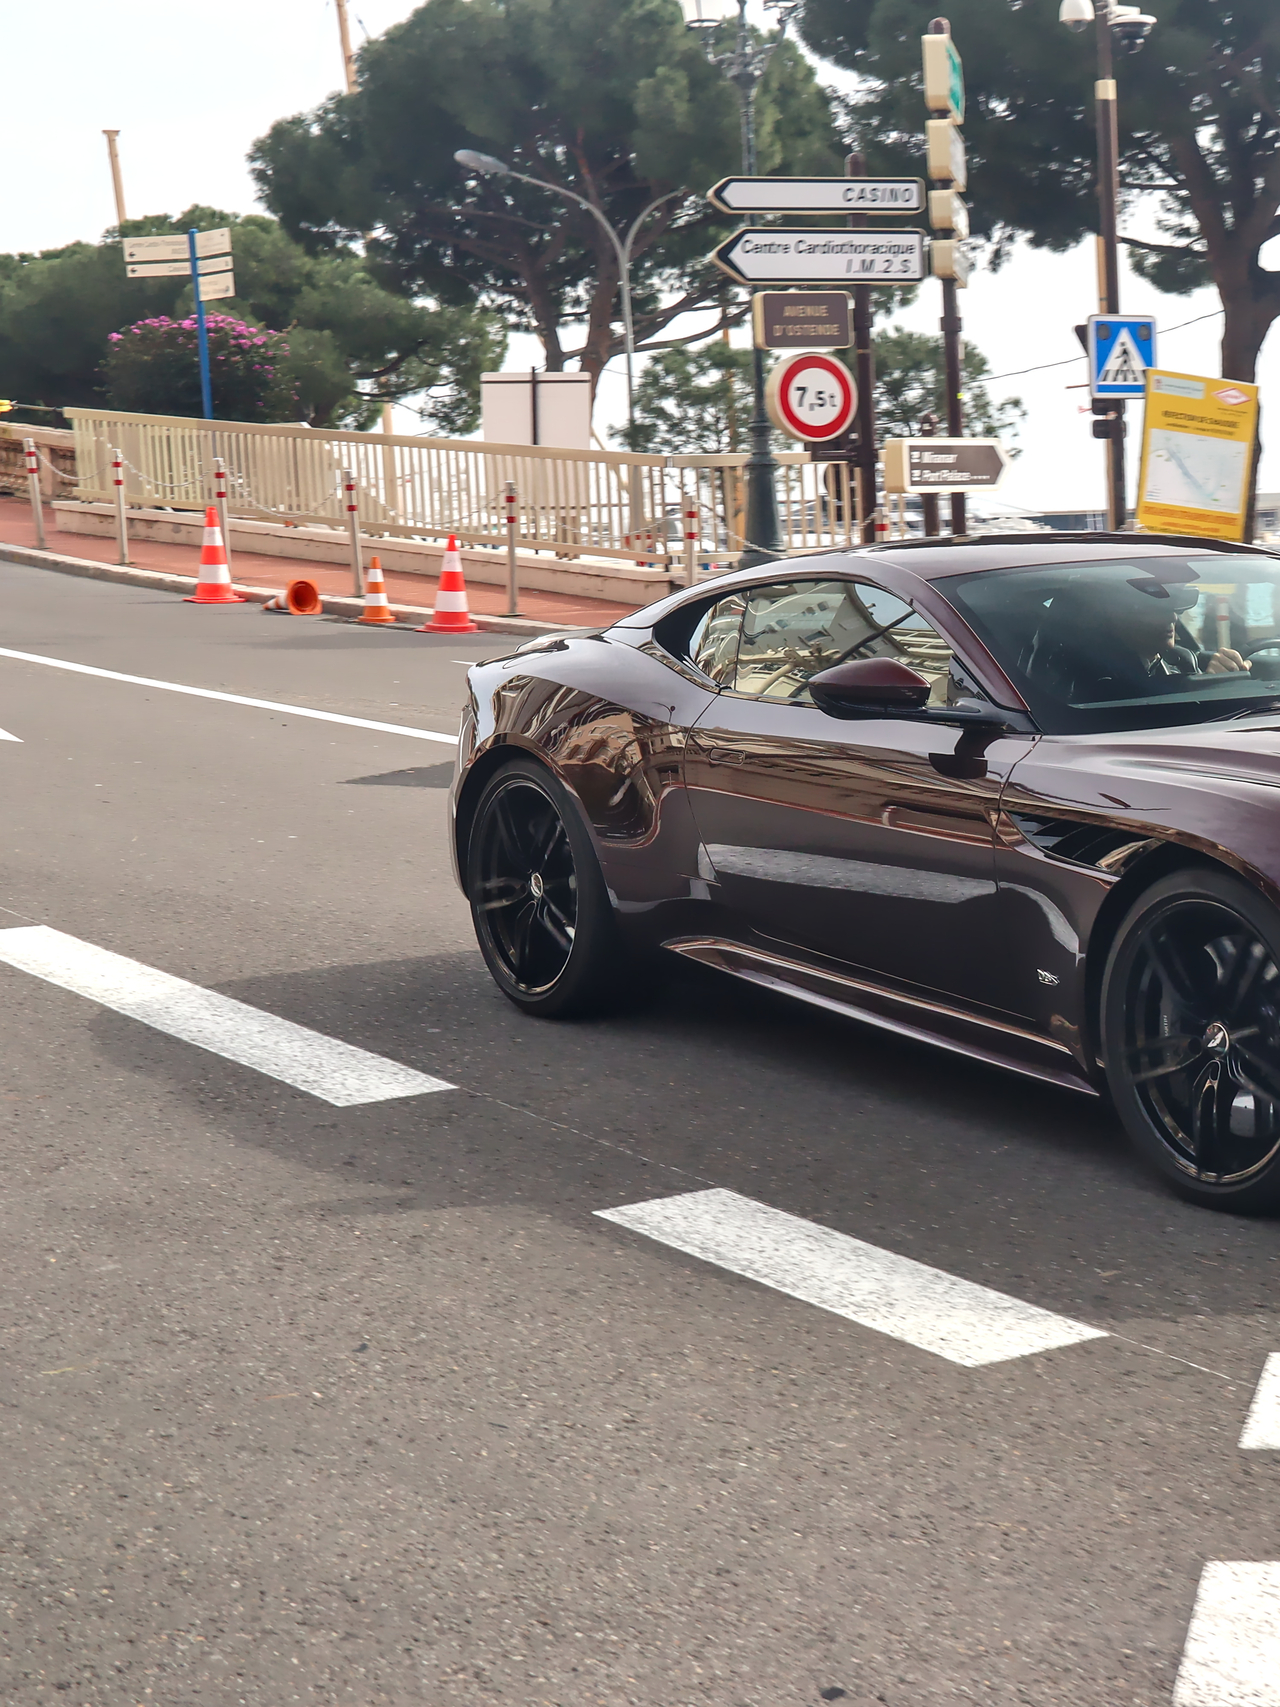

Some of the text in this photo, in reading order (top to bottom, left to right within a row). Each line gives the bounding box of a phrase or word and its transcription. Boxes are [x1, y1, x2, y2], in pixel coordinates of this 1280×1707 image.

[842, 187, 914, 203] CASINO
[740, 239, 916, 258] Centre Cardiothoracique
[783, 305, 829, 317] AVENUE
[772, 324, 841, 337] D'OSTENDE
